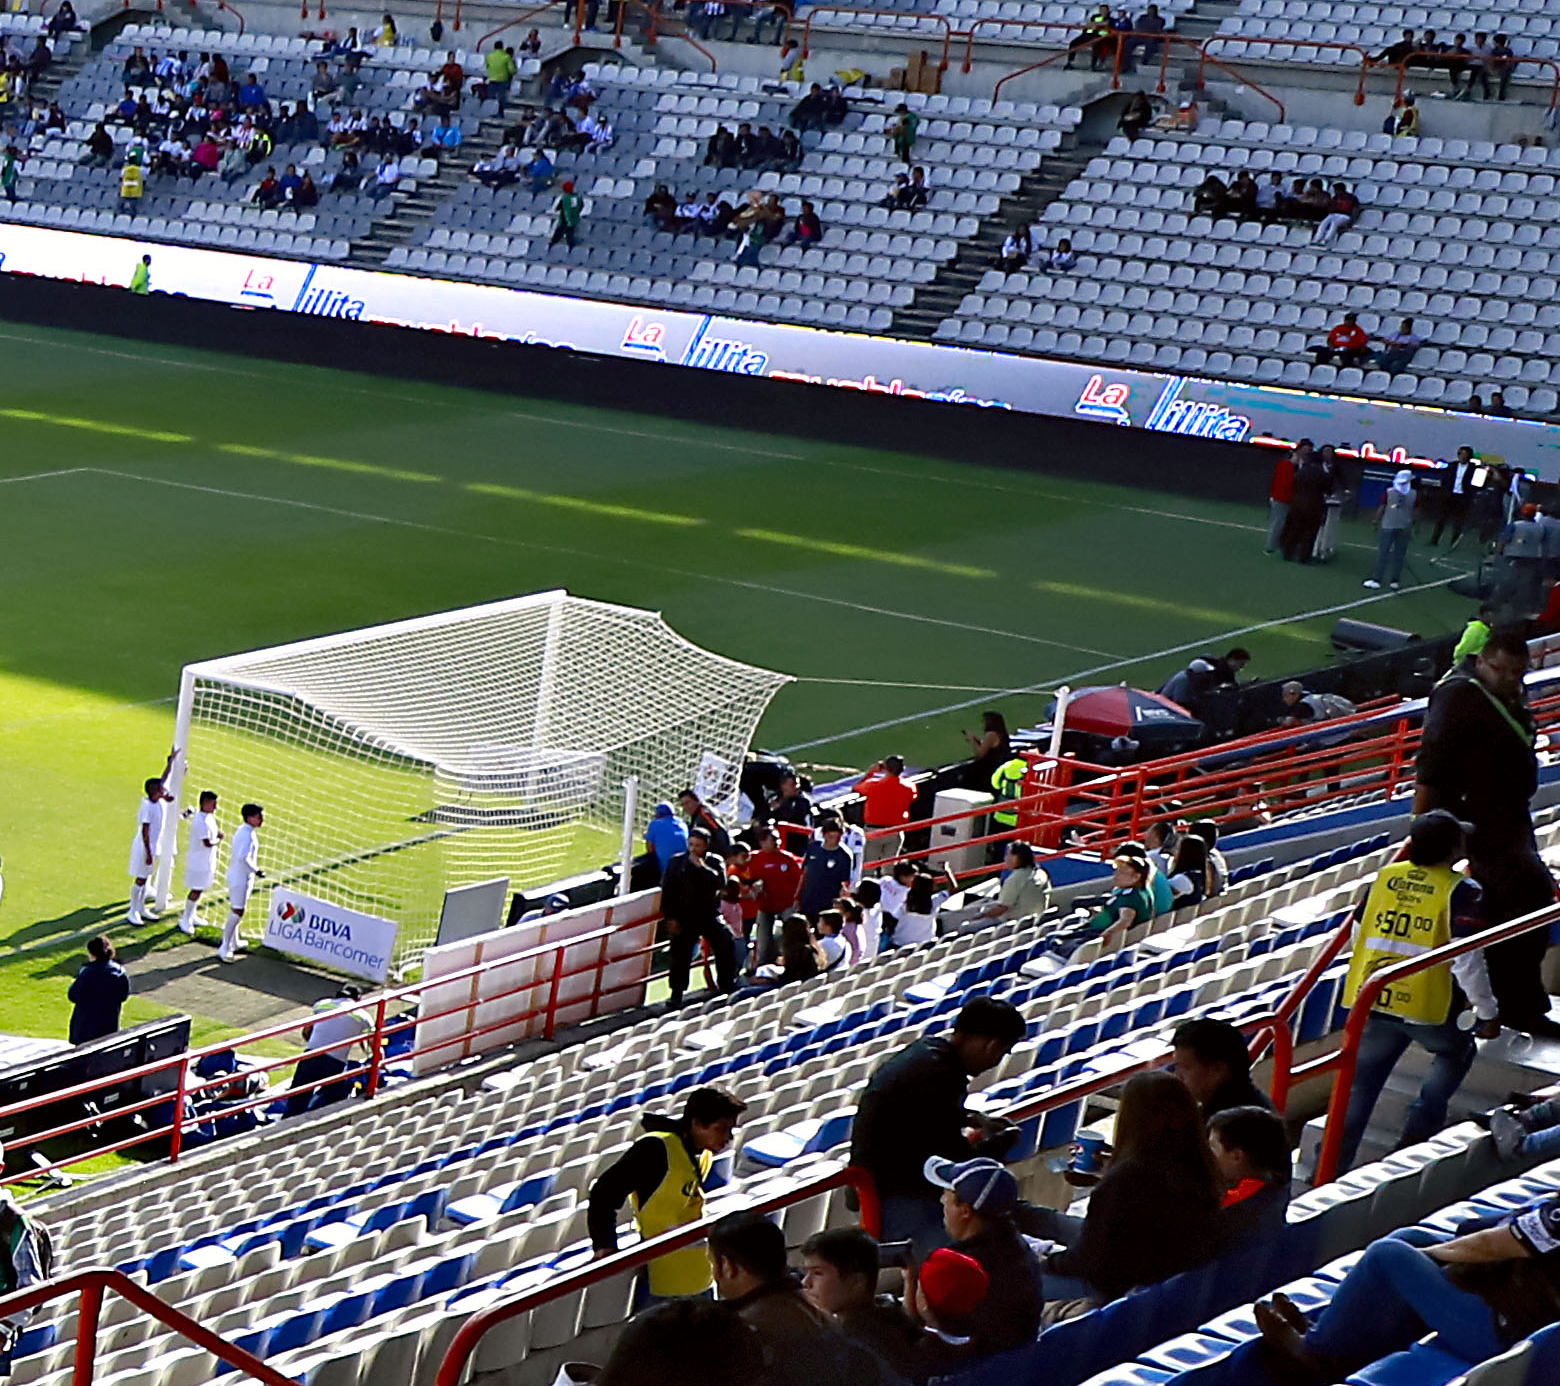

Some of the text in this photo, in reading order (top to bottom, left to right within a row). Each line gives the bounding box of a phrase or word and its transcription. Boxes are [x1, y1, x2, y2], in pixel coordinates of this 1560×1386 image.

[243, 269, 275, 290] La
[626, 317, 663, 343] La
[1078, 375, 1131, 405] La
[1387, 874, 1436, 896] Corona
[308, 914, 352, 941] BBVA
[268, 922, 384, 970] LIGA Bancomer
